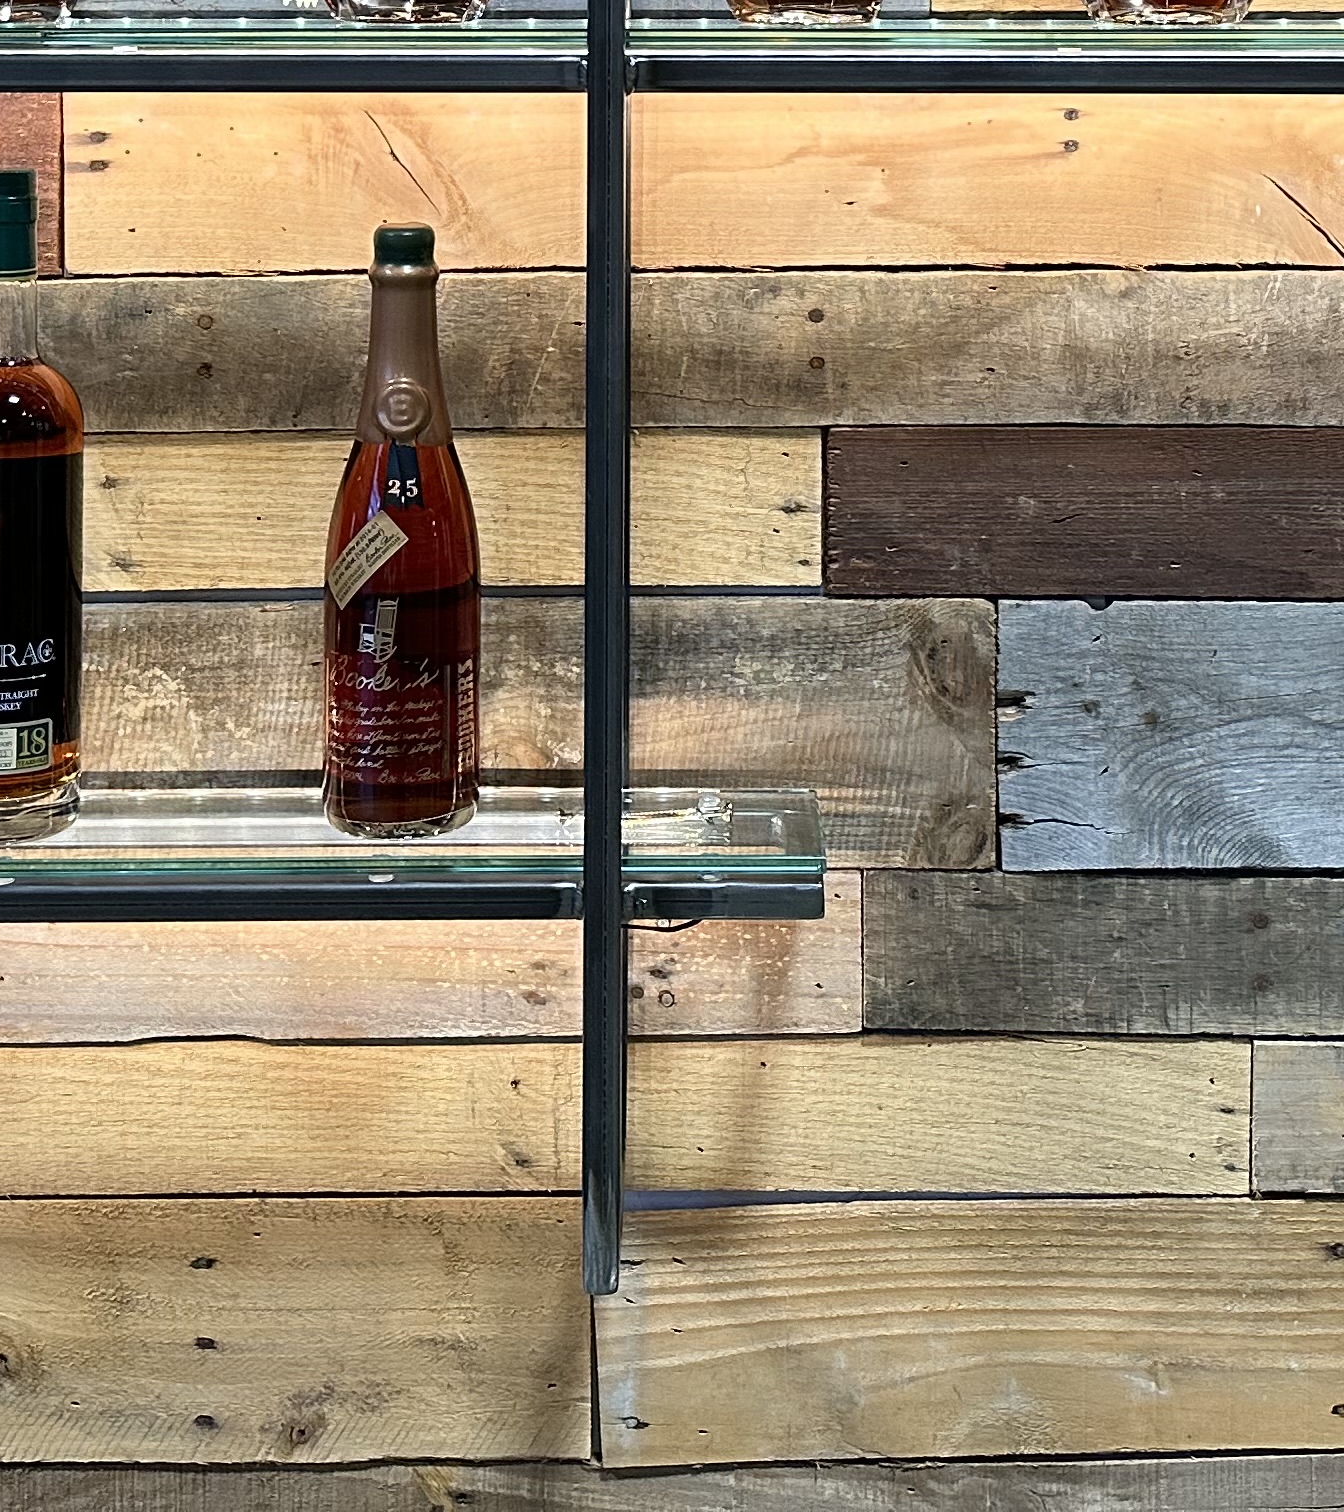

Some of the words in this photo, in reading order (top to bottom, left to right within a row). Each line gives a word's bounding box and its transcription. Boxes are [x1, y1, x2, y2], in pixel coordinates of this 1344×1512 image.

[388, 477, 419, 499] 25
[330, 654, 440, 692] Booker's
[19, 727, 46, 757] 18
